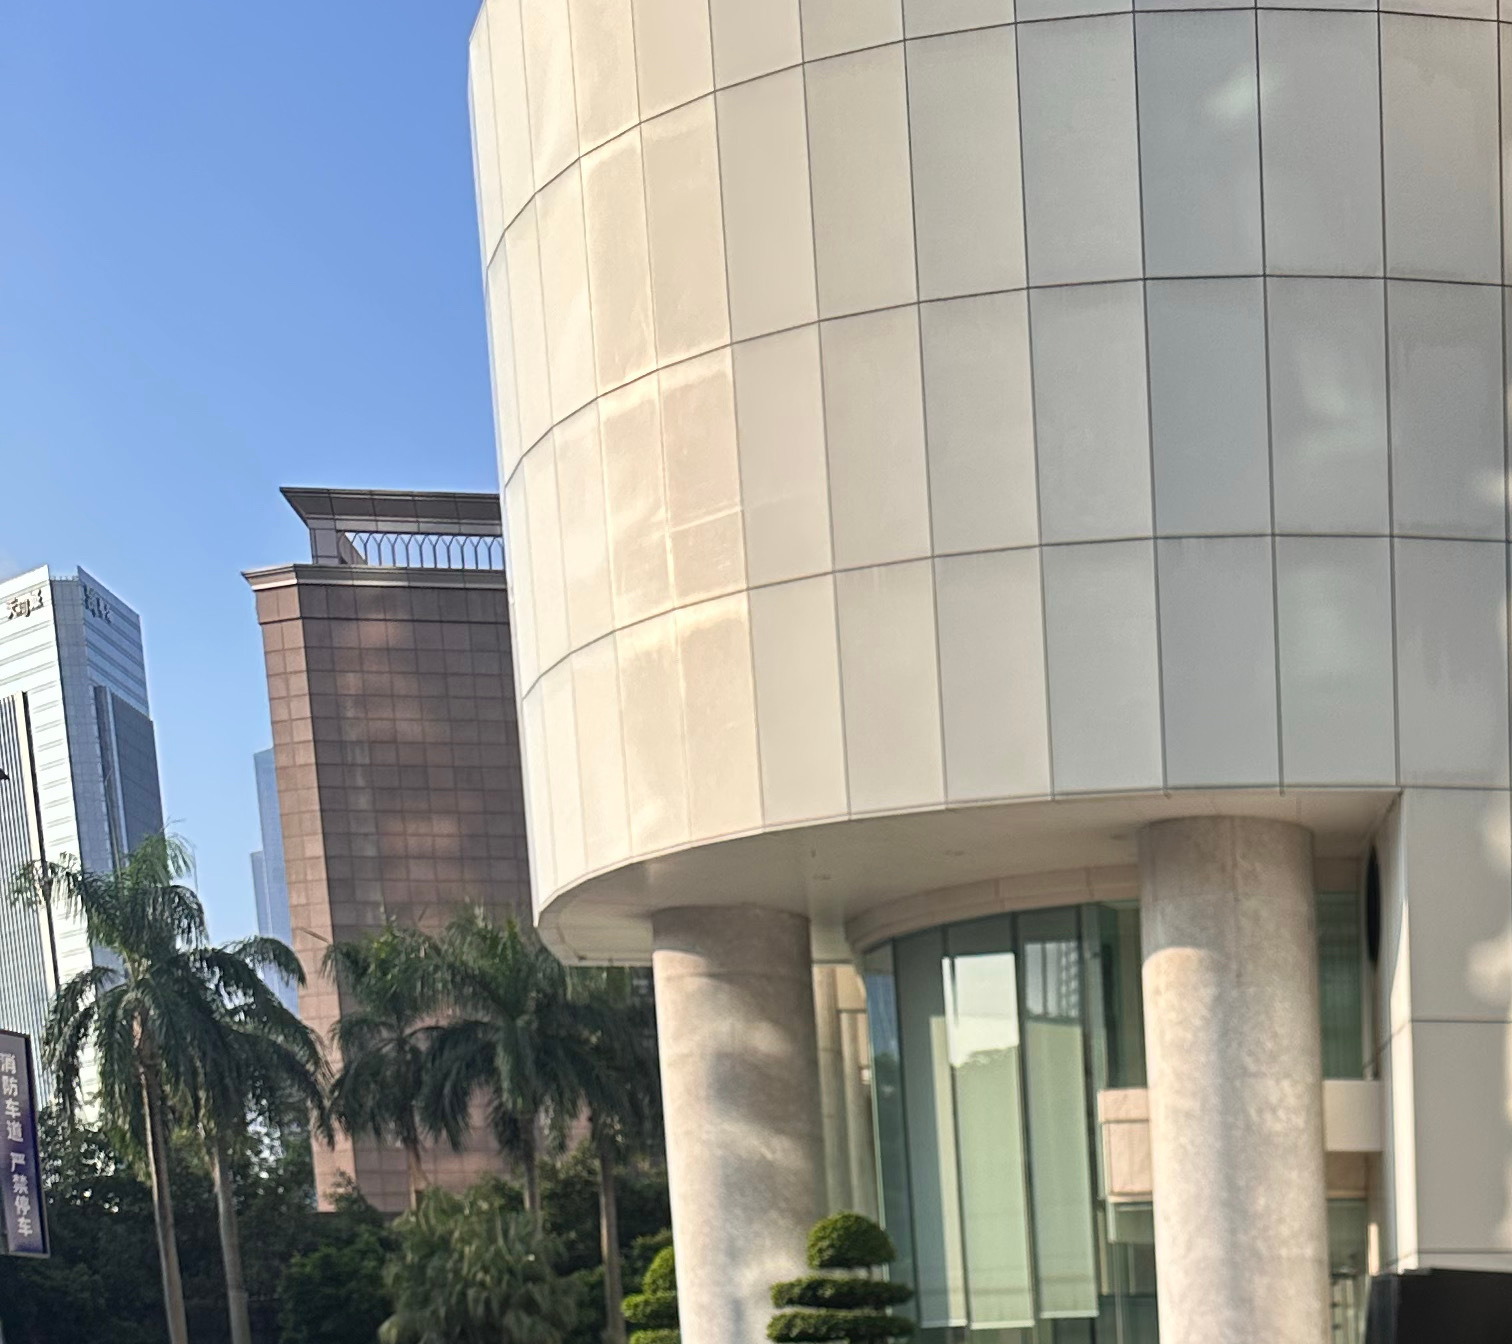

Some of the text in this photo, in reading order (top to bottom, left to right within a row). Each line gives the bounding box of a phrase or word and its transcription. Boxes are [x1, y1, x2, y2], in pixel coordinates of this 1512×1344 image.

[0, 1053, 33, 1238] 消防车道 严禁停车
